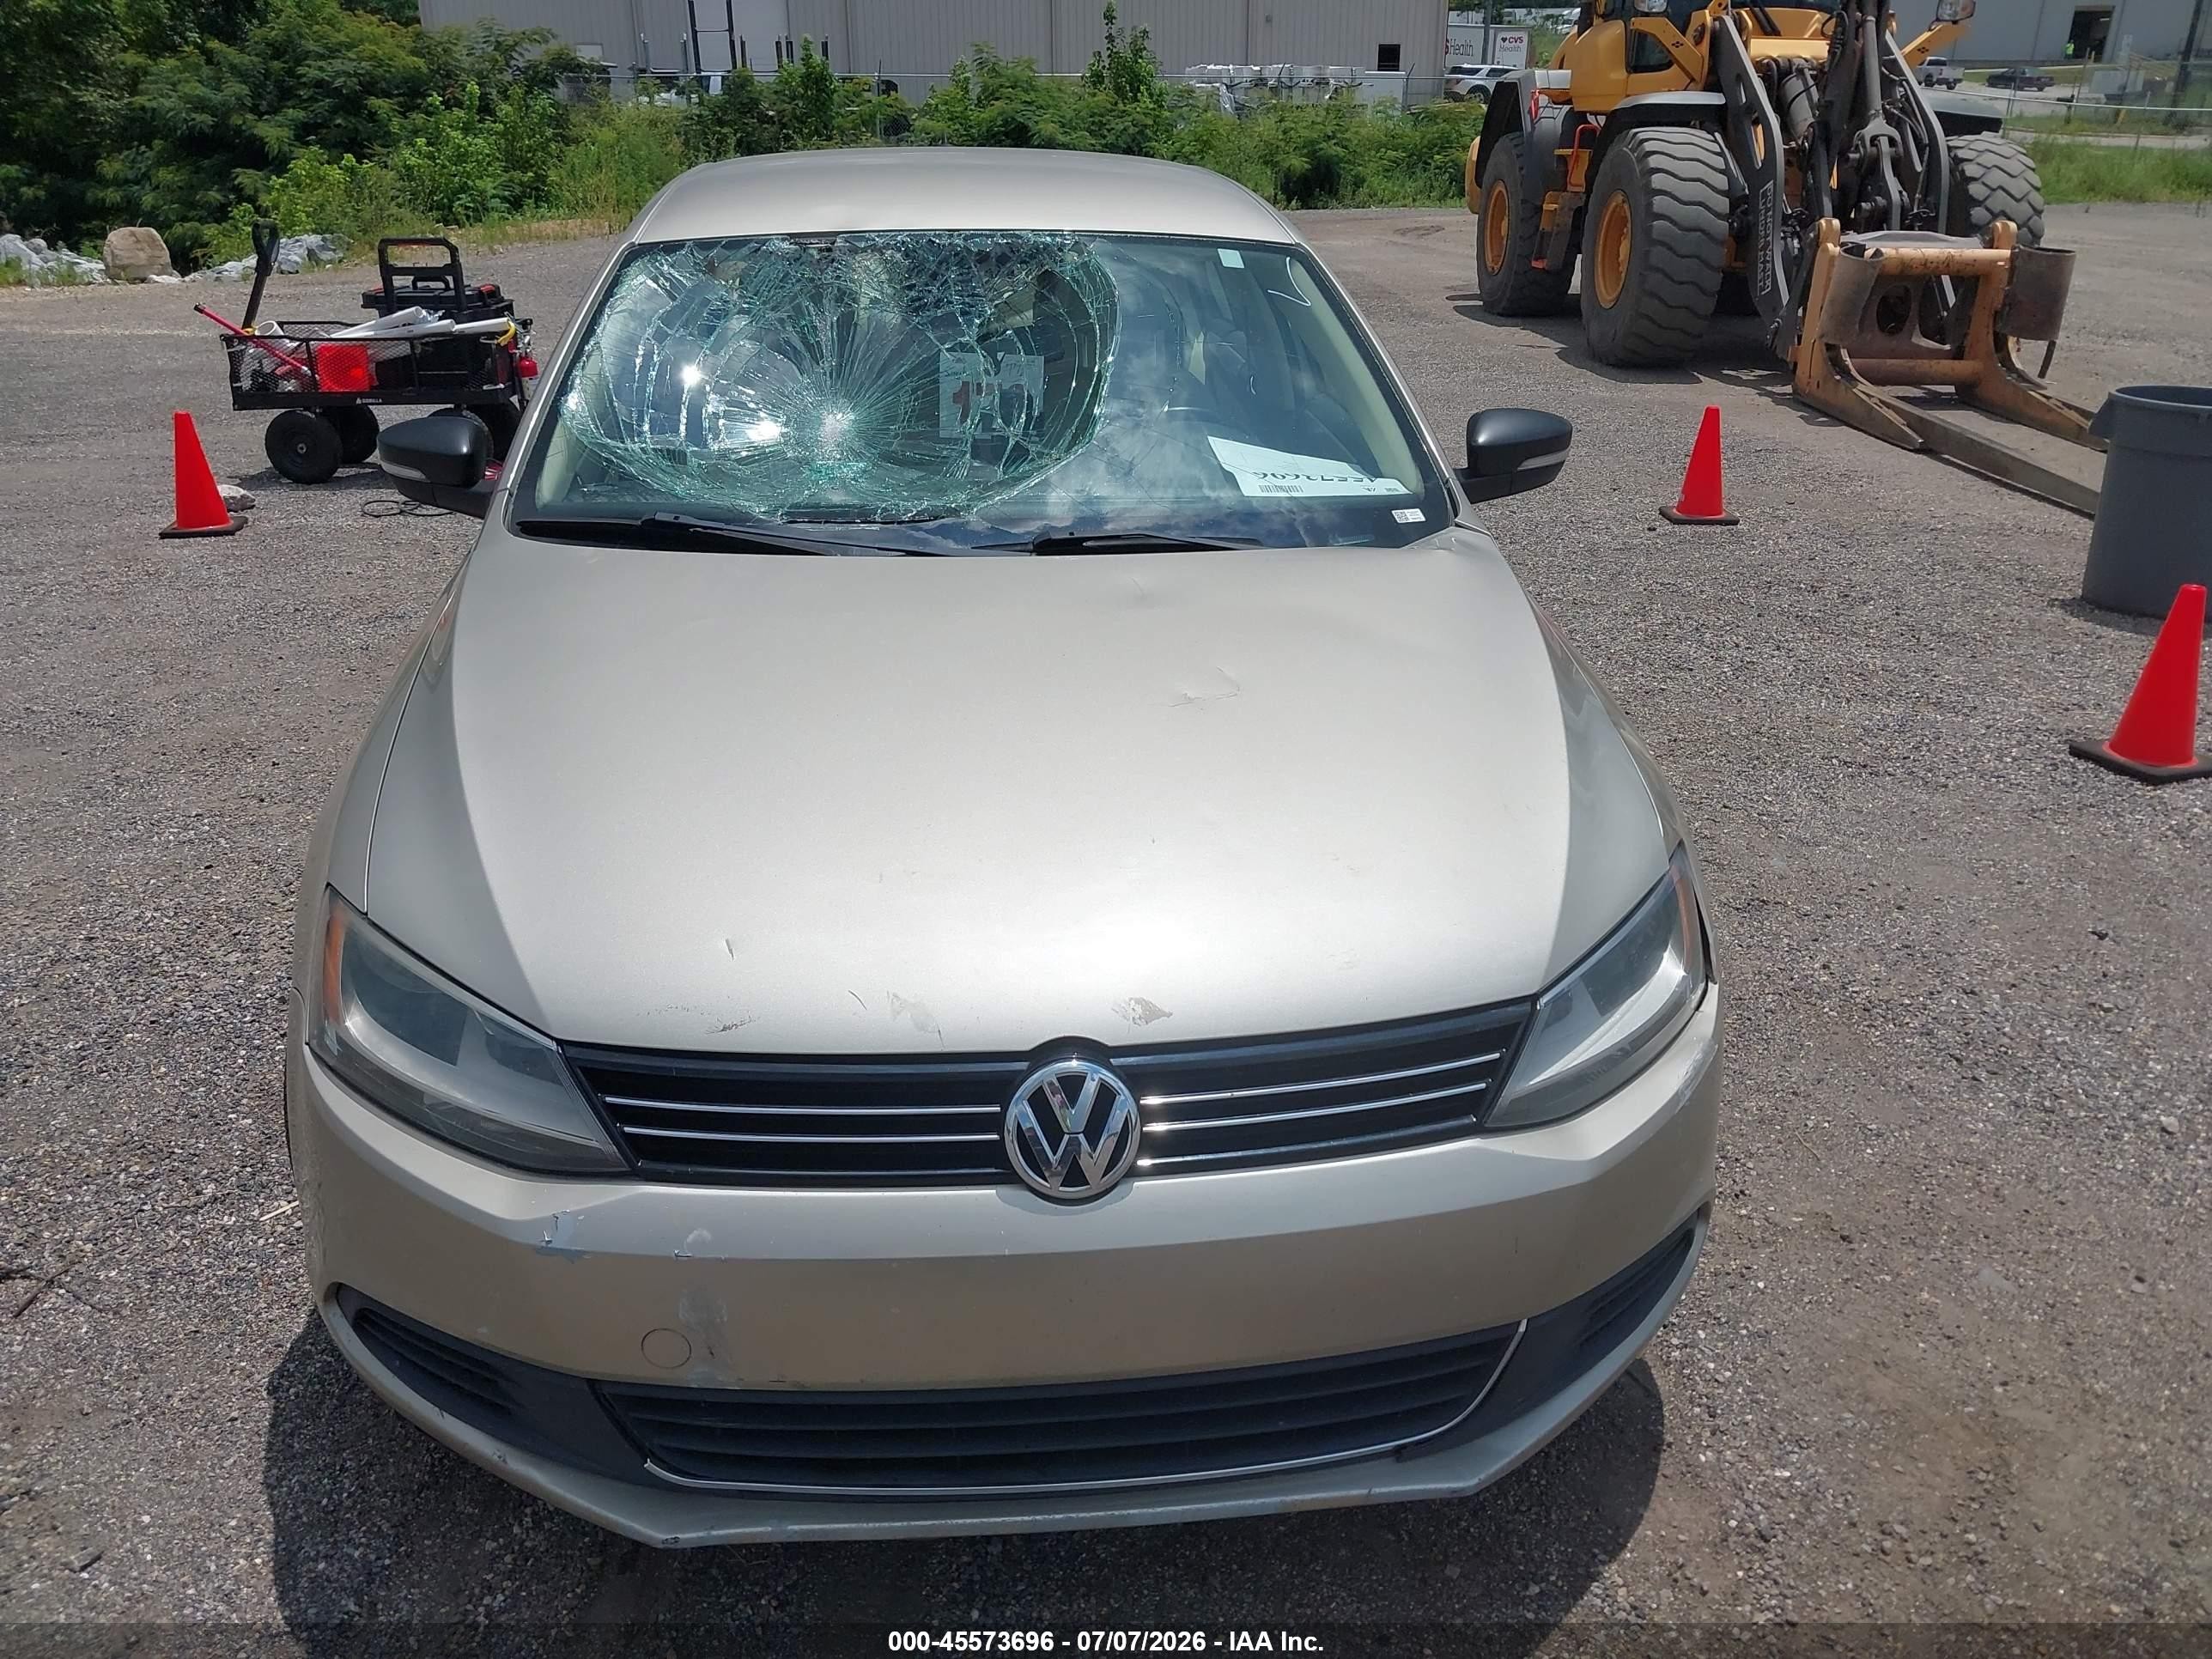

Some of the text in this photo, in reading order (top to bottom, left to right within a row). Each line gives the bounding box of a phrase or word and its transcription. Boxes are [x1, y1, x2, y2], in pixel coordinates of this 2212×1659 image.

[1449, 38, 1474, 57] Health
[1508, 36, 1524, 45] CVS
[1499, 44, 1522, 52] Health
[1012, 1067, 1134, 1194] VW
